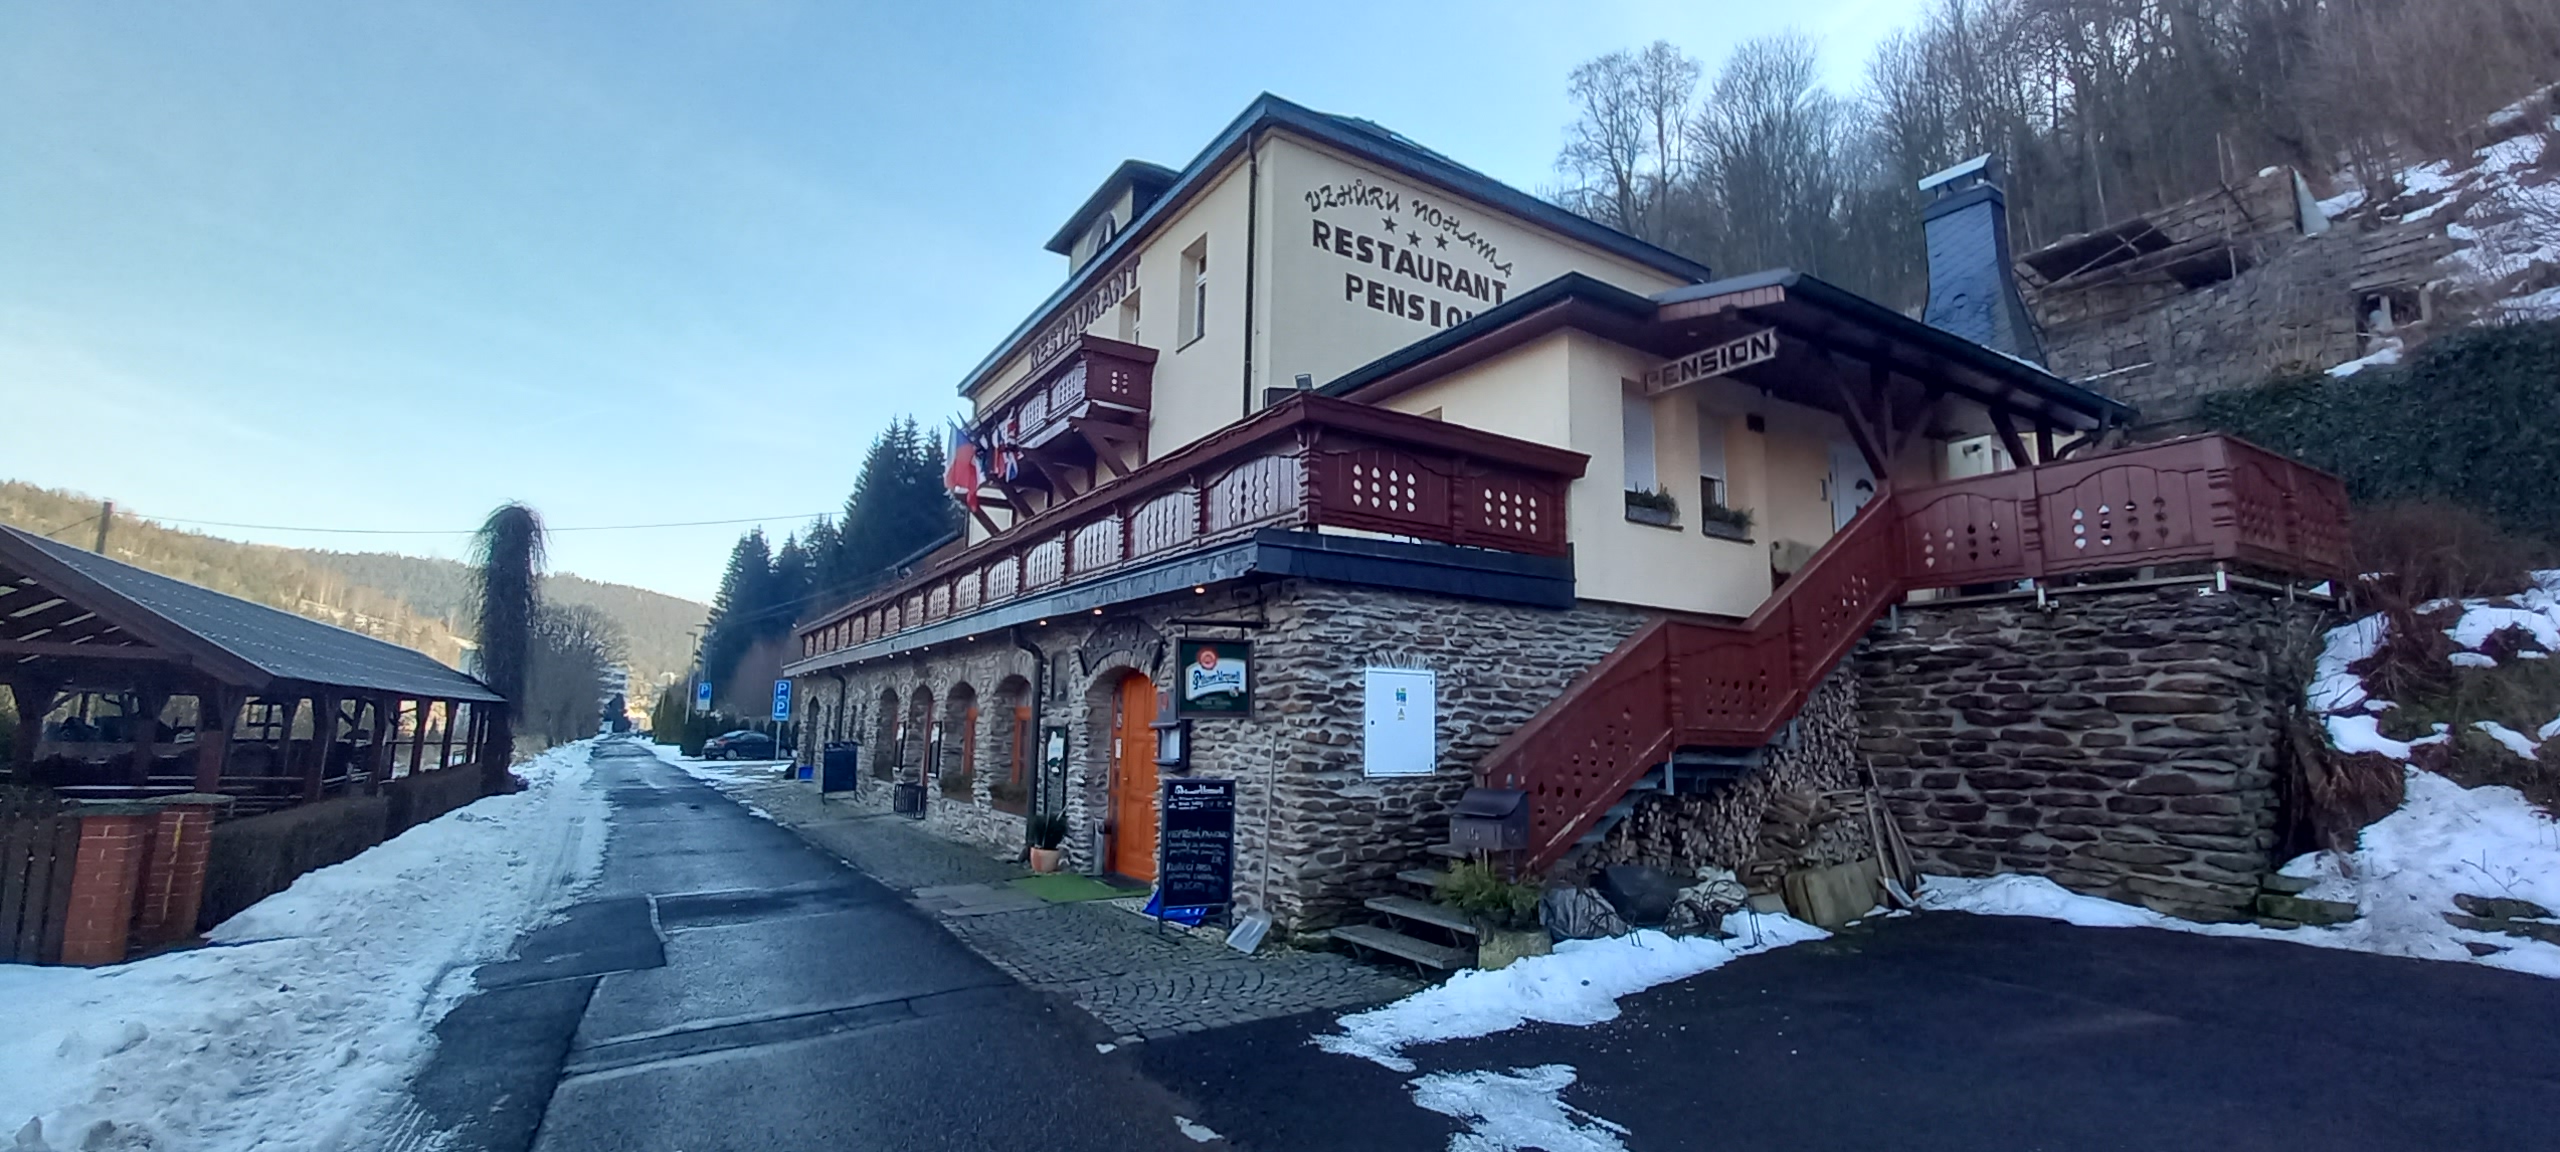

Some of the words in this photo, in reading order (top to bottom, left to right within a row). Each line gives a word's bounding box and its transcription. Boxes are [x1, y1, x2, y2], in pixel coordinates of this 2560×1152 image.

[1312, 218, 1508, 305] RESTAURANT
[1411, 199, 1514, 279] NOHAMA
[1643, 331, 1772, 393] PENSION
[777, 702, 785, 713] P
[778, 683, 787, 694] P
